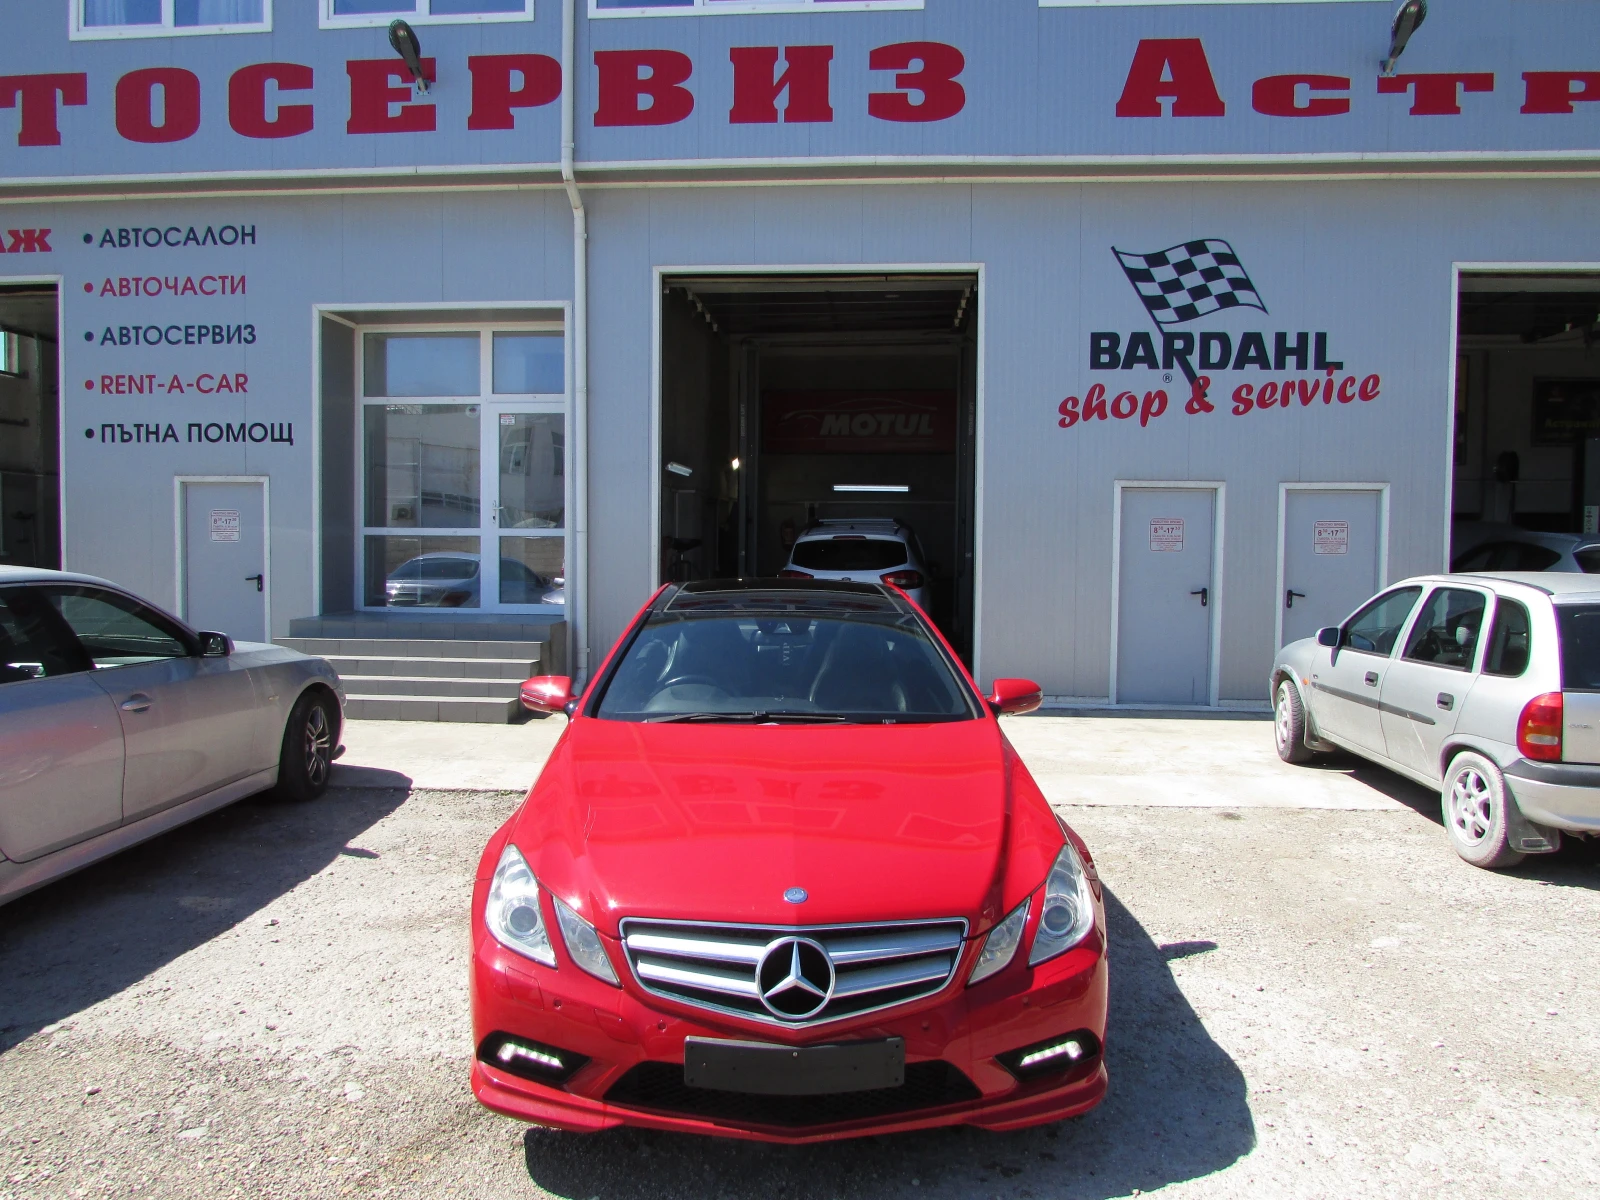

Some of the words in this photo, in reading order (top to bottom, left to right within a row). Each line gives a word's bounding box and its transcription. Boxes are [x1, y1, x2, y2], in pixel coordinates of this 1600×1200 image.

[99, 225, 256, 248] АВТОСАЛОН
[100, 275, 246, 297] АВТОЧАСТИ
[100, 324, 257, 346] АВТОСЕРВИЗ
[1089, 331, 1344, 371] BARDAHL
[100, 373, 249, 395] RENT-A-CAR
[1058, 383, 1168, 428] shop
[1185, 376, 1215, 415] &
[1231, 365, 1381, 416] service
[101, 423, 179, 443] ПЪТНА
[187, 422, 293, 446] ПОМОЩ
[819, 413, 934, 437] MOTUL
